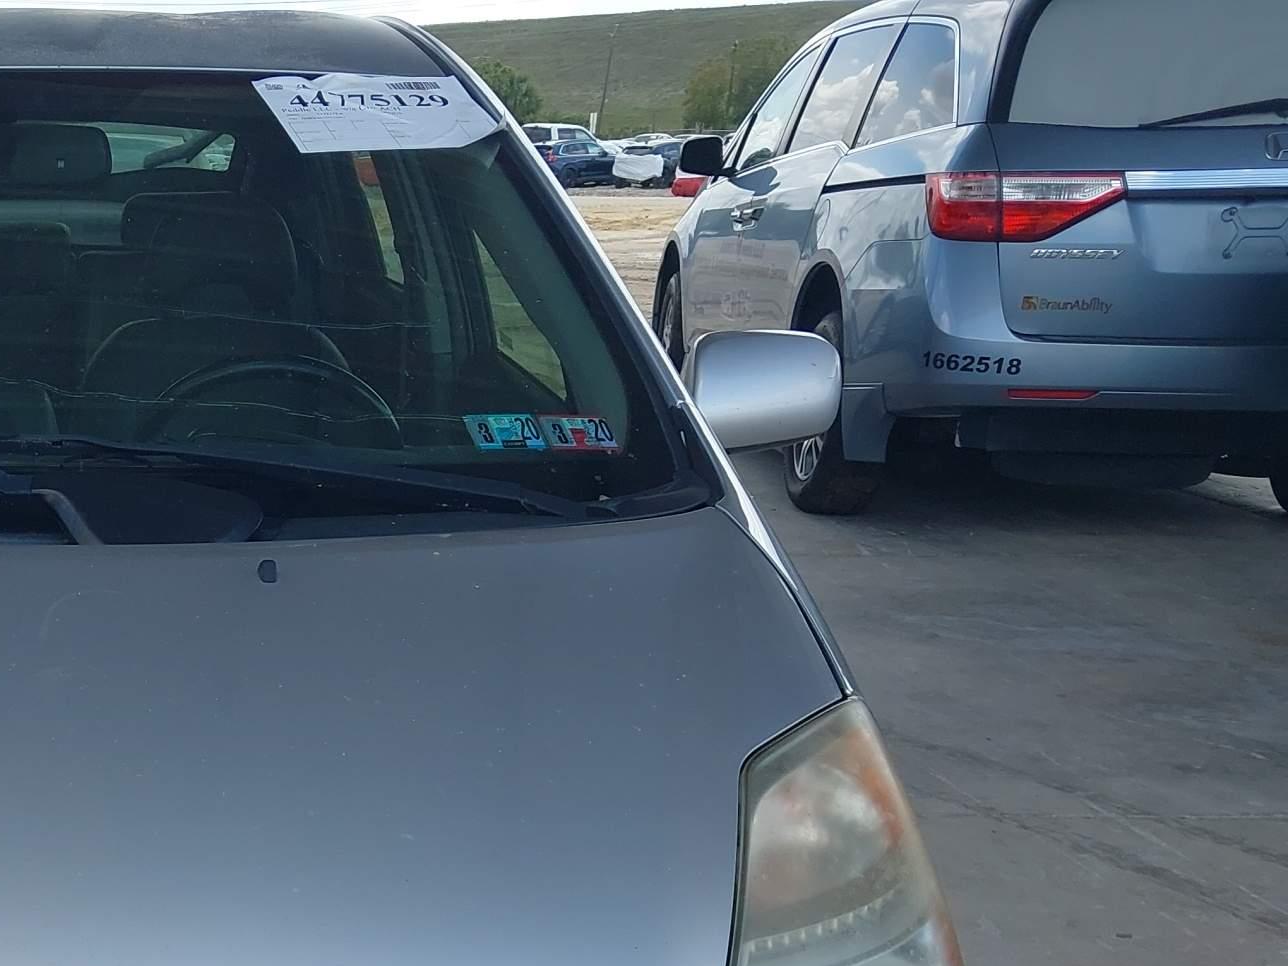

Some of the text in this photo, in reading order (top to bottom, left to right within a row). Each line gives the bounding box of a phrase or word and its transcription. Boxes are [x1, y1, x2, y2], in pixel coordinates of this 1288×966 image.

[289, 90, 449, 108] 44775129
[1030, 248, 1126, 260] ODYSSEY
[1039, 297, 1112, 314] BraunAbility
[922, 350, 1022, 375] 1662518
[514, 418, 540, 440] 20
[588, 419, 614, 441] 20
